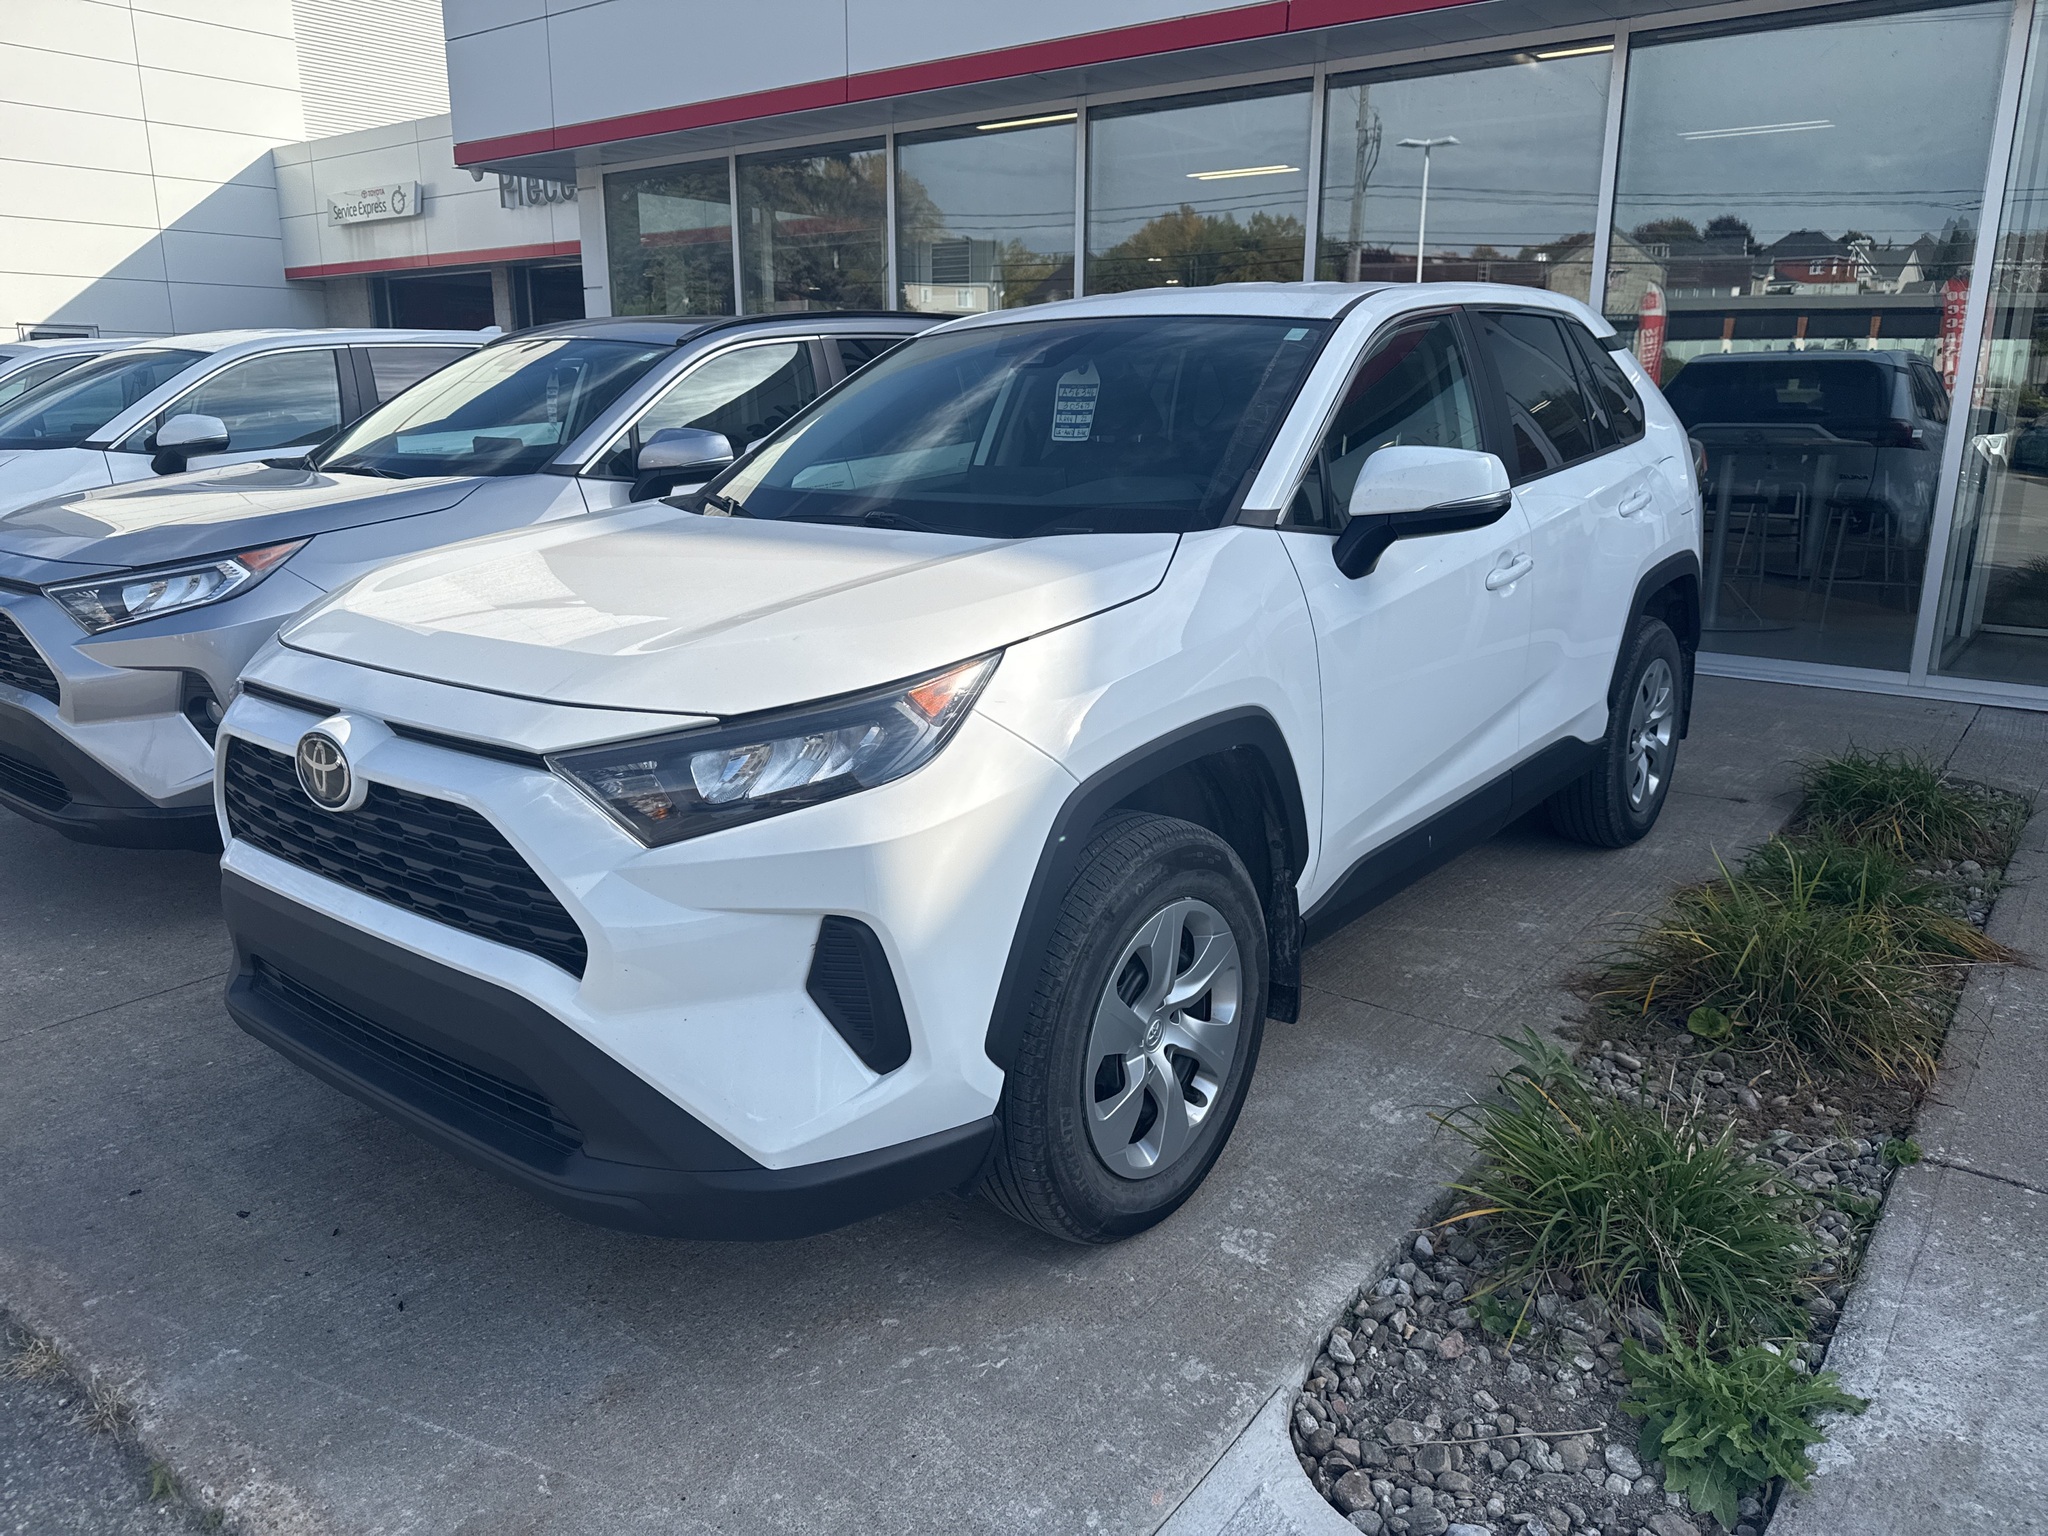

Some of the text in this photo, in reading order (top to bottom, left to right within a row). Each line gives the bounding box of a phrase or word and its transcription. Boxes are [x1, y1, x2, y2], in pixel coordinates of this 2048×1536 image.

[367, 188, 386, 197] TOYOTA
[333, 200, 387, 220] Service Express
